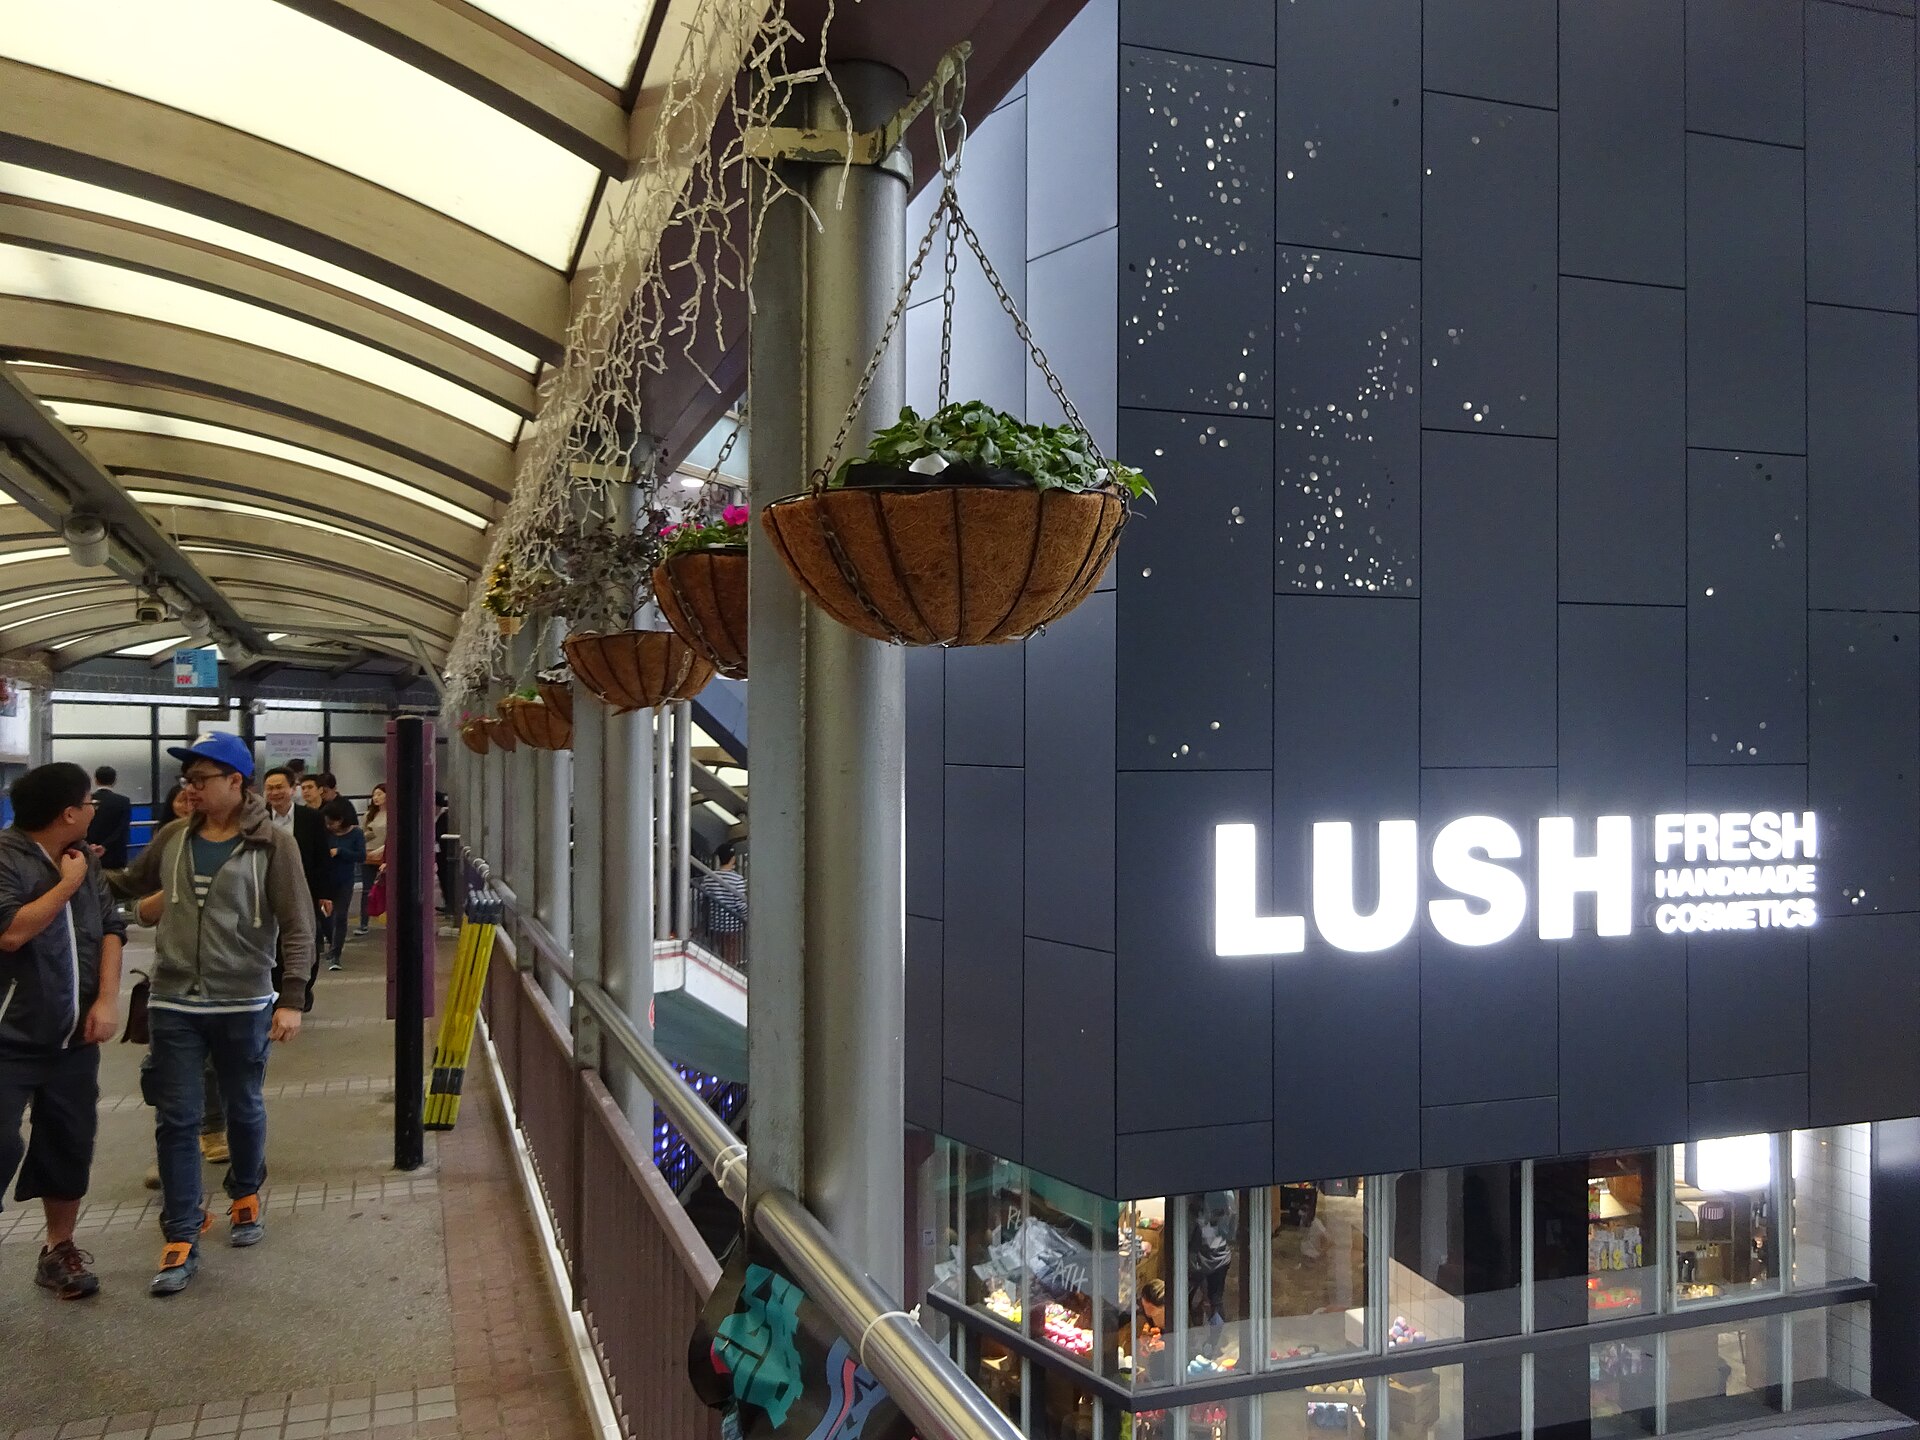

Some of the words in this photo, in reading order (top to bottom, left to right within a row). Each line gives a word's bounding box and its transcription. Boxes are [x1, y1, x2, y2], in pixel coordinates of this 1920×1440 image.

[1655, 811, 1816, 862] FRESH
[1215, 815, 1632, 956] LUSH
[1655, 865, 1816, 898] HANDMADE
[1655, 898, 1817, 934] COSMETICS
